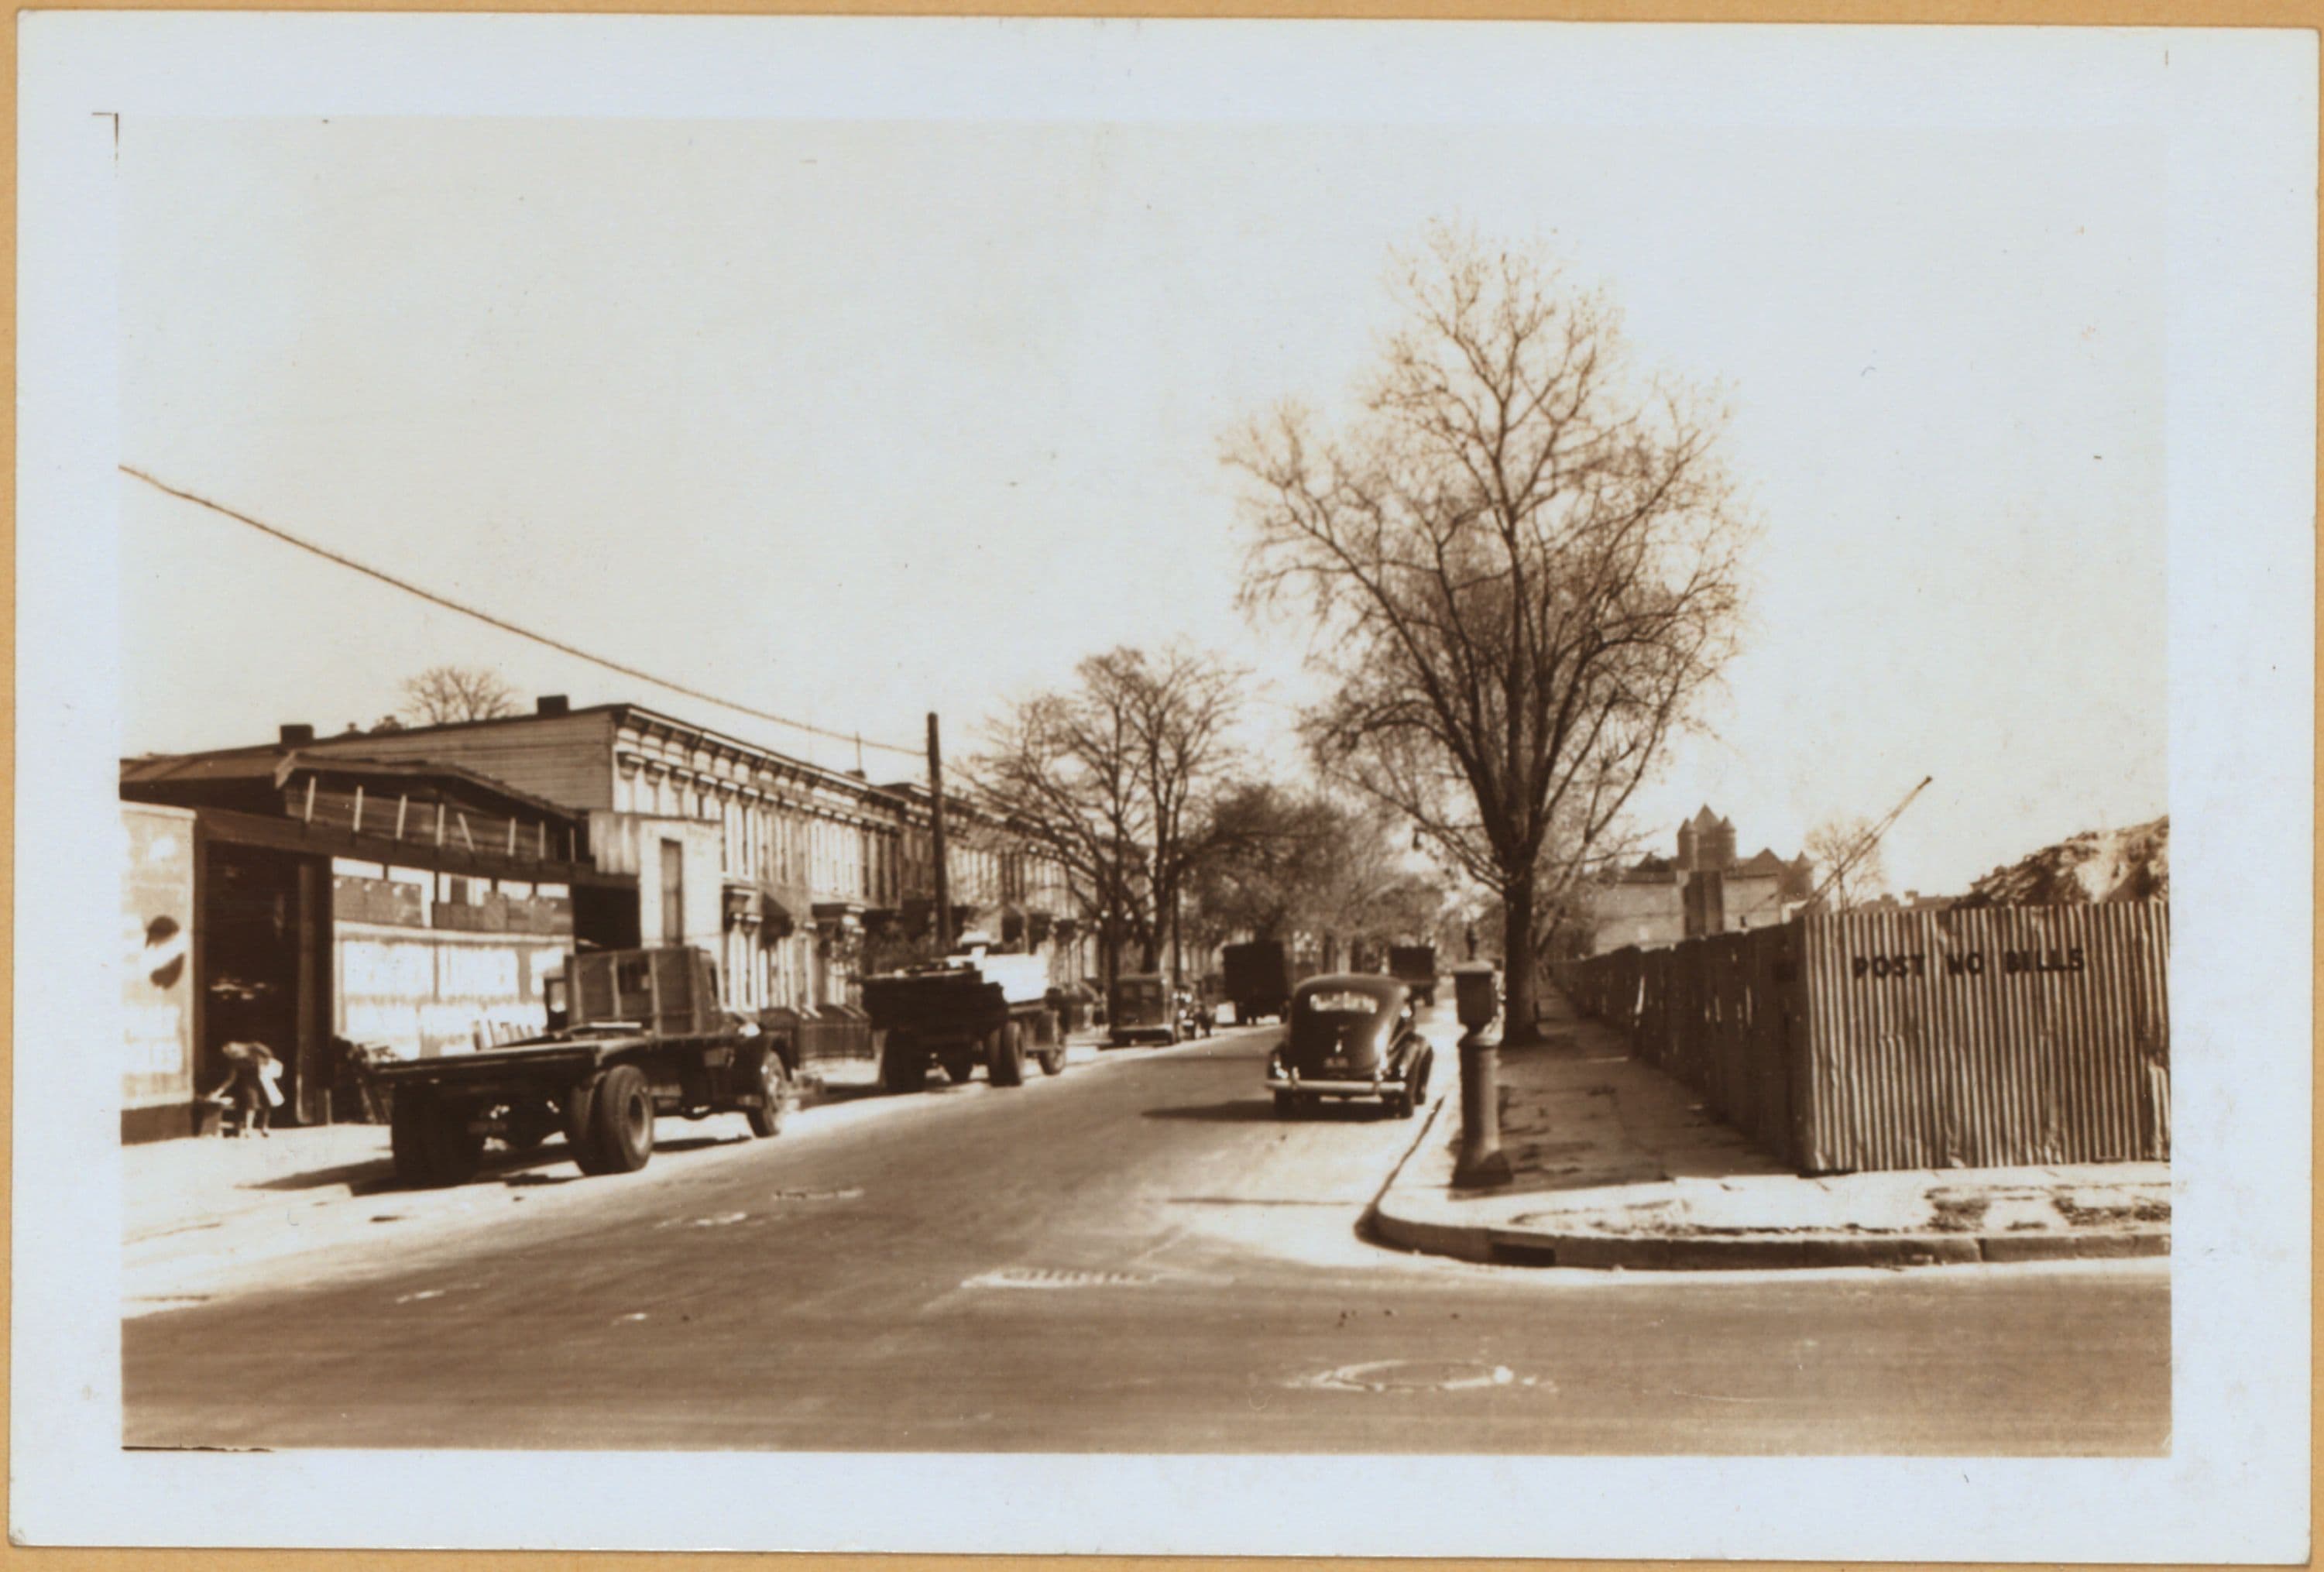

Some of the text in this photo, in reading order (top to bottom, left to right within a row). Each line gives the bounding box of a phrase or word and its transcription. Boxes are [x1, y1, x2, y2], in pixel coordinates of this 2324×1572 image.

[1853, 947, 2085, 978] POST NO BILLS
